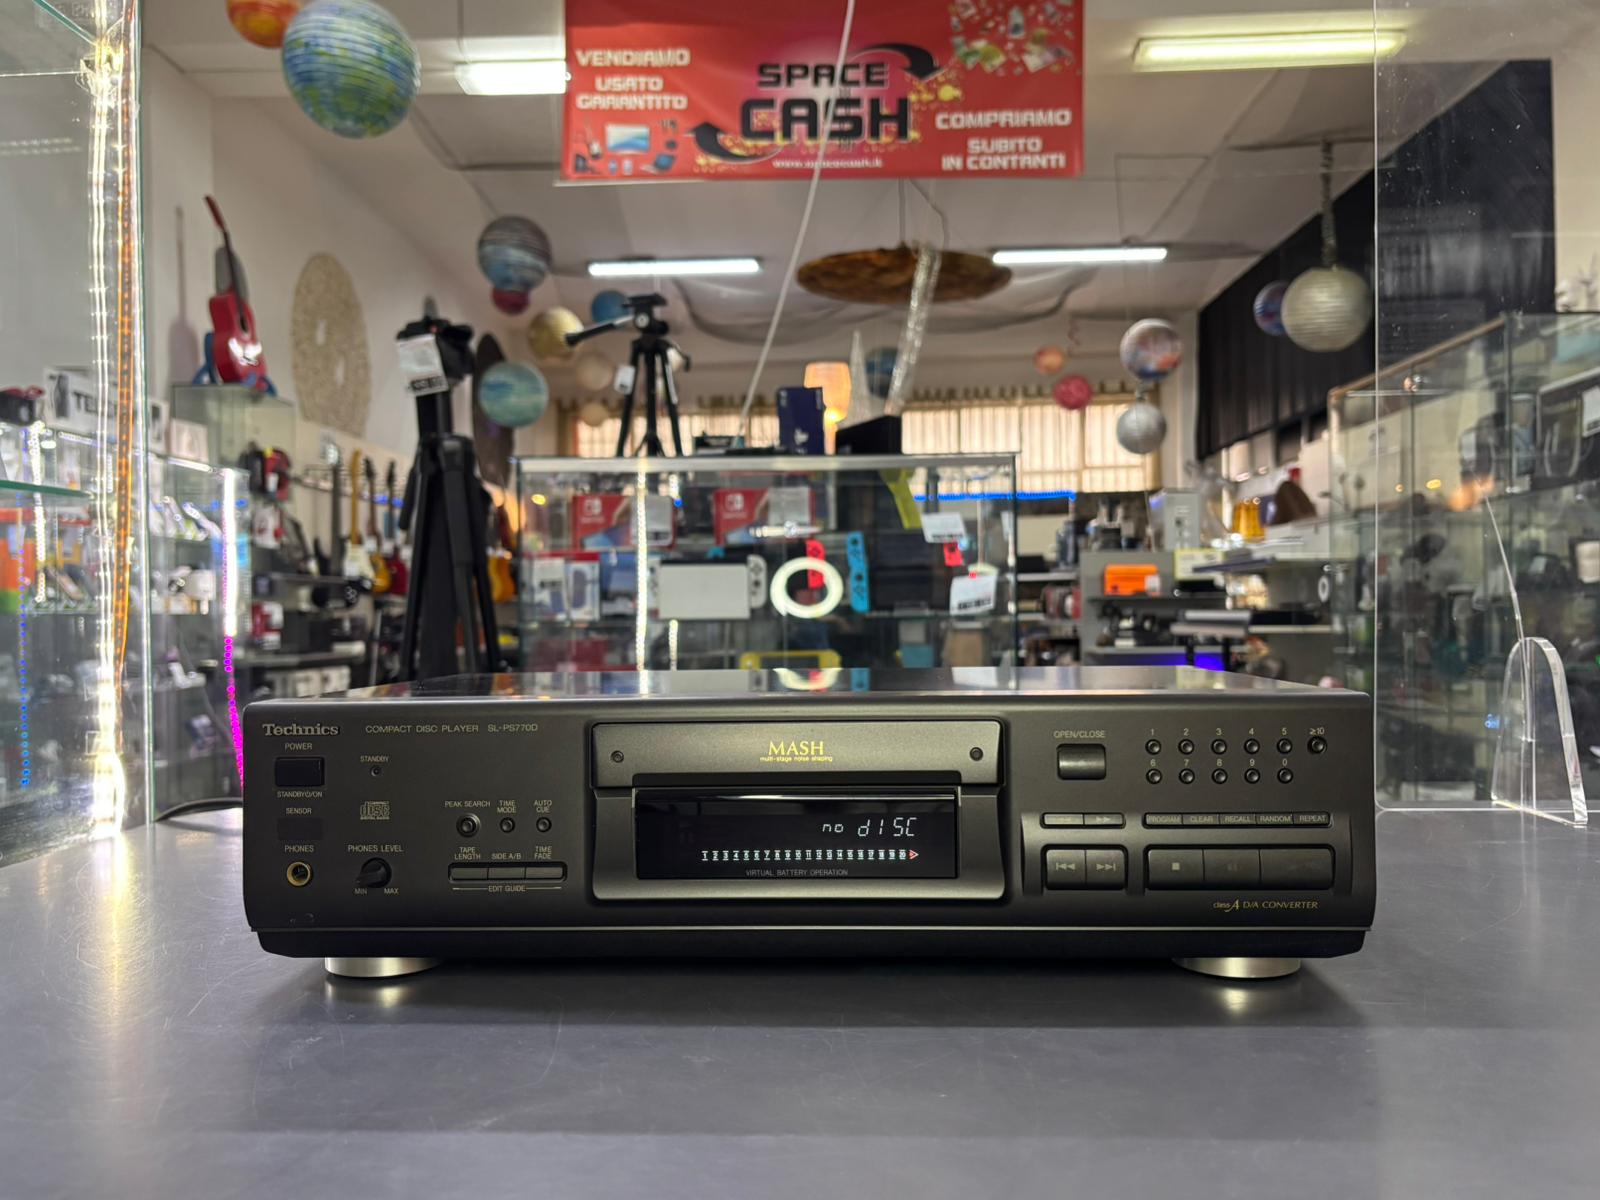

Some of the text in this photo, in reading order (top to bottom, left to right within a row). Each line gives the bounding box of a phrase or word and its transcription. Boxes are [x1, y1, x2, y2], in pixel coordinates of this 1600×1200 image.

[576, 48, 690, 67] VENDIAMO
[757, 63, 888, 88] SPACE
[595, 76, 663, 92] USATO
[576, 94, 688, 110] GARANTITO
[740, 98, 912, 143] CASH
[935, 109, 1073, 130] COMPRIAMO
[968, 137, 1041, 153] SUBITO
[941, 152, 1067, 171] IN CONTANTI
[262, 723, 340, 737] Technics
[365, 724, 538, 733] COMPACT DISC PLAYER SL-PS770D
[1150, 728, 1155, 736] 1
[1183, 728, 1189, 736] 2
[1216, 728, 1222, 736] 3
[1248, 728, 1254, 736] 4
[1281, 728, 1287, 736] 5
[1053, 730, 1105, 739] OPEN/CLOSE
[284, 742, 313, 751] POWER
[768, 741, 825, 756] MASH
[360, 755, 389, 763] STANDBY
[759, 755, 792, 763] multi-stage
[1150, 758, 1288, 767] 6 7 8 9 0
[445, 800, 491, 808] PEAK SEARCH
[499, 800, 516, 808] TIME
[534, 800, 552, 808] AUTO
[286, 807, 312, 815] SENSOR
[1190, 814, 1214, 823] CLEAR
[1224, 814, 1250, 823] RECALL
[1260, 814, 1290, 823] RANDOM
[1299, 813, 1326, 823] REPEAT
[822, 822, 844, 833] no
[285, 844, 314, 853] PHONES
[348, 844, 403, 853] PHONES LEVEL
[459, 846, 476, 854] TAPE
[535, 845, 552, 853] TIME
[454, 852, 481, 860] LENGTH
[491, 852, 522, 860] SIDE A/B
[534, 852, 552, 860] FADE
[746, 869, 848, 877] VIRTUAL BATTERY OPERATION
[488, 884, 526, 892] EDIT GUIDE
[1242, 901, 1259, 909] D/A
[1262, 900, 1318, 909] CONVERTER
